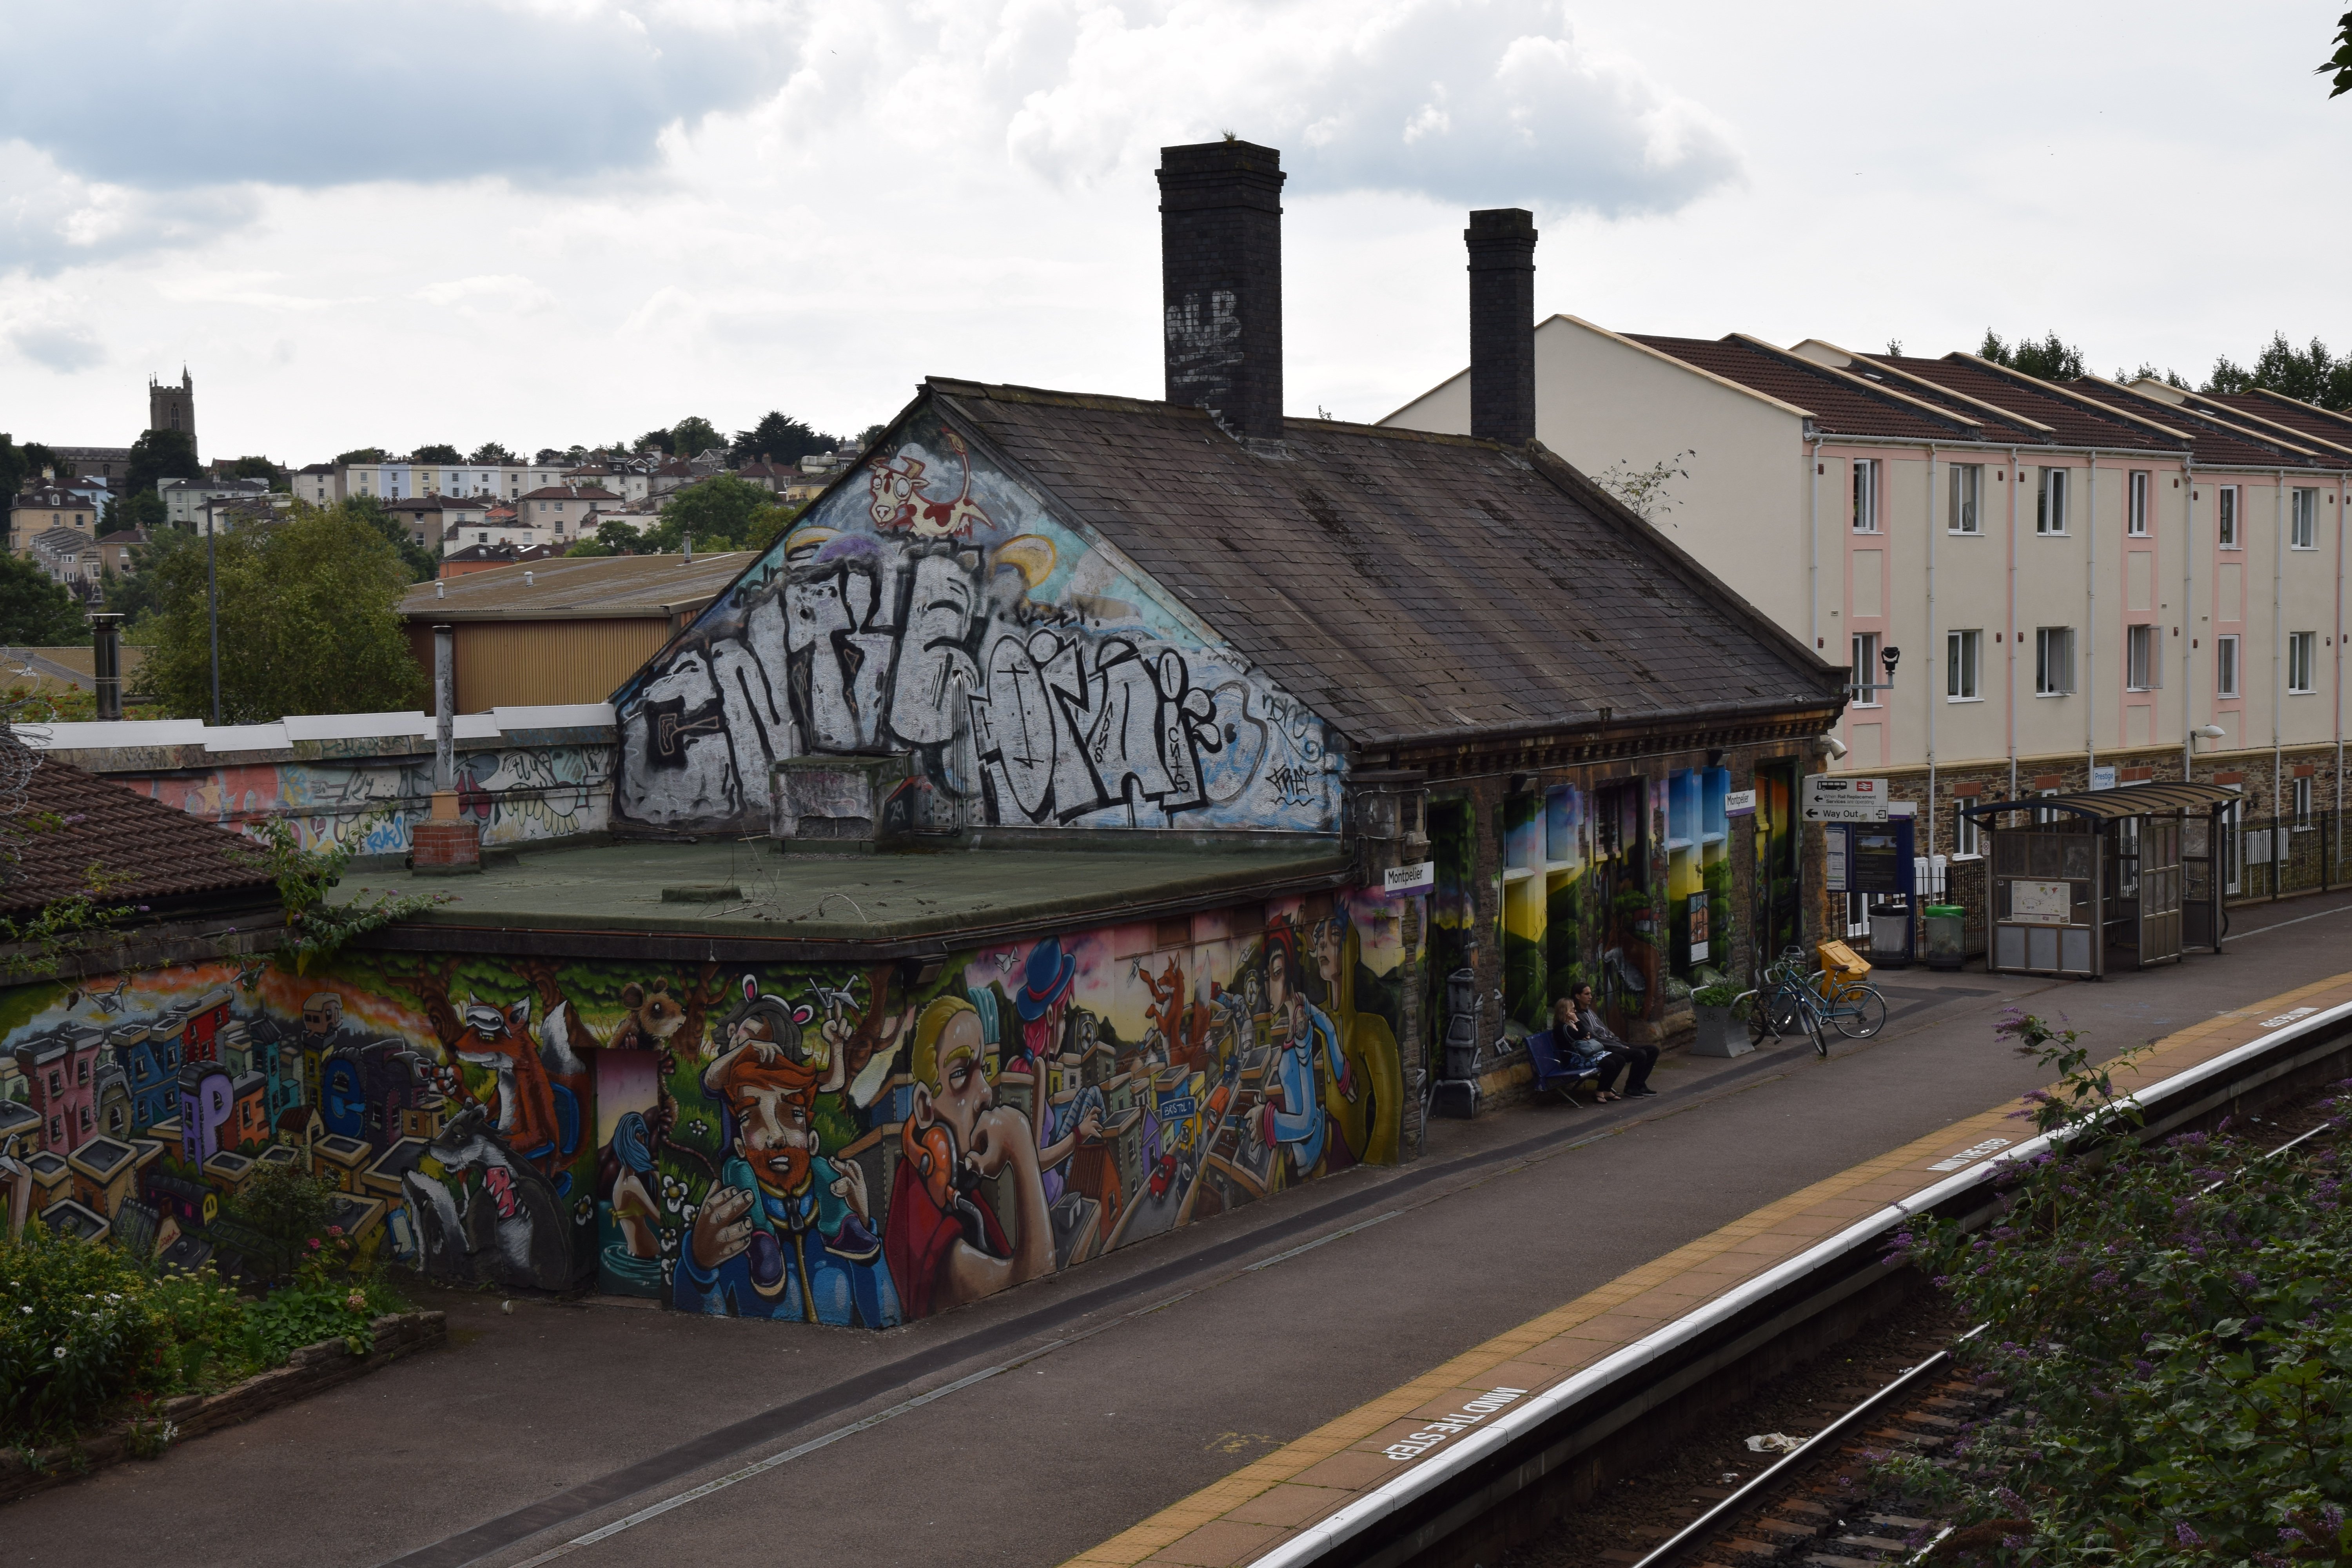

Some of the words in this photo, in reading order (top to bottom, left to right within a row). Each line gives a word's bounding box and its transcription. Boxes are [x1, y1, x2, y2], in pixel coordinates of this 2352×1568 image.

[2095, 772, 2113, 780] Prestige
[1727, 793, 1749, 806] Montpelier
[1823, 810, 1840, 818] Way
[1388, 867, 1423, 885] Montpelier
[1164, 1102, 1187, 1116] BRISTOL
[1926, 1158, 1971, 1171] MIND
[1952, 1149, 1992, 1159] THE
[1973, 1138, 2013, 1150] STEP
[1463, 1387, 1528, 1412] MIND
[1423, 1414, 1486, 1434] THE
[1382, 1432, 1446, 1460] STEP
